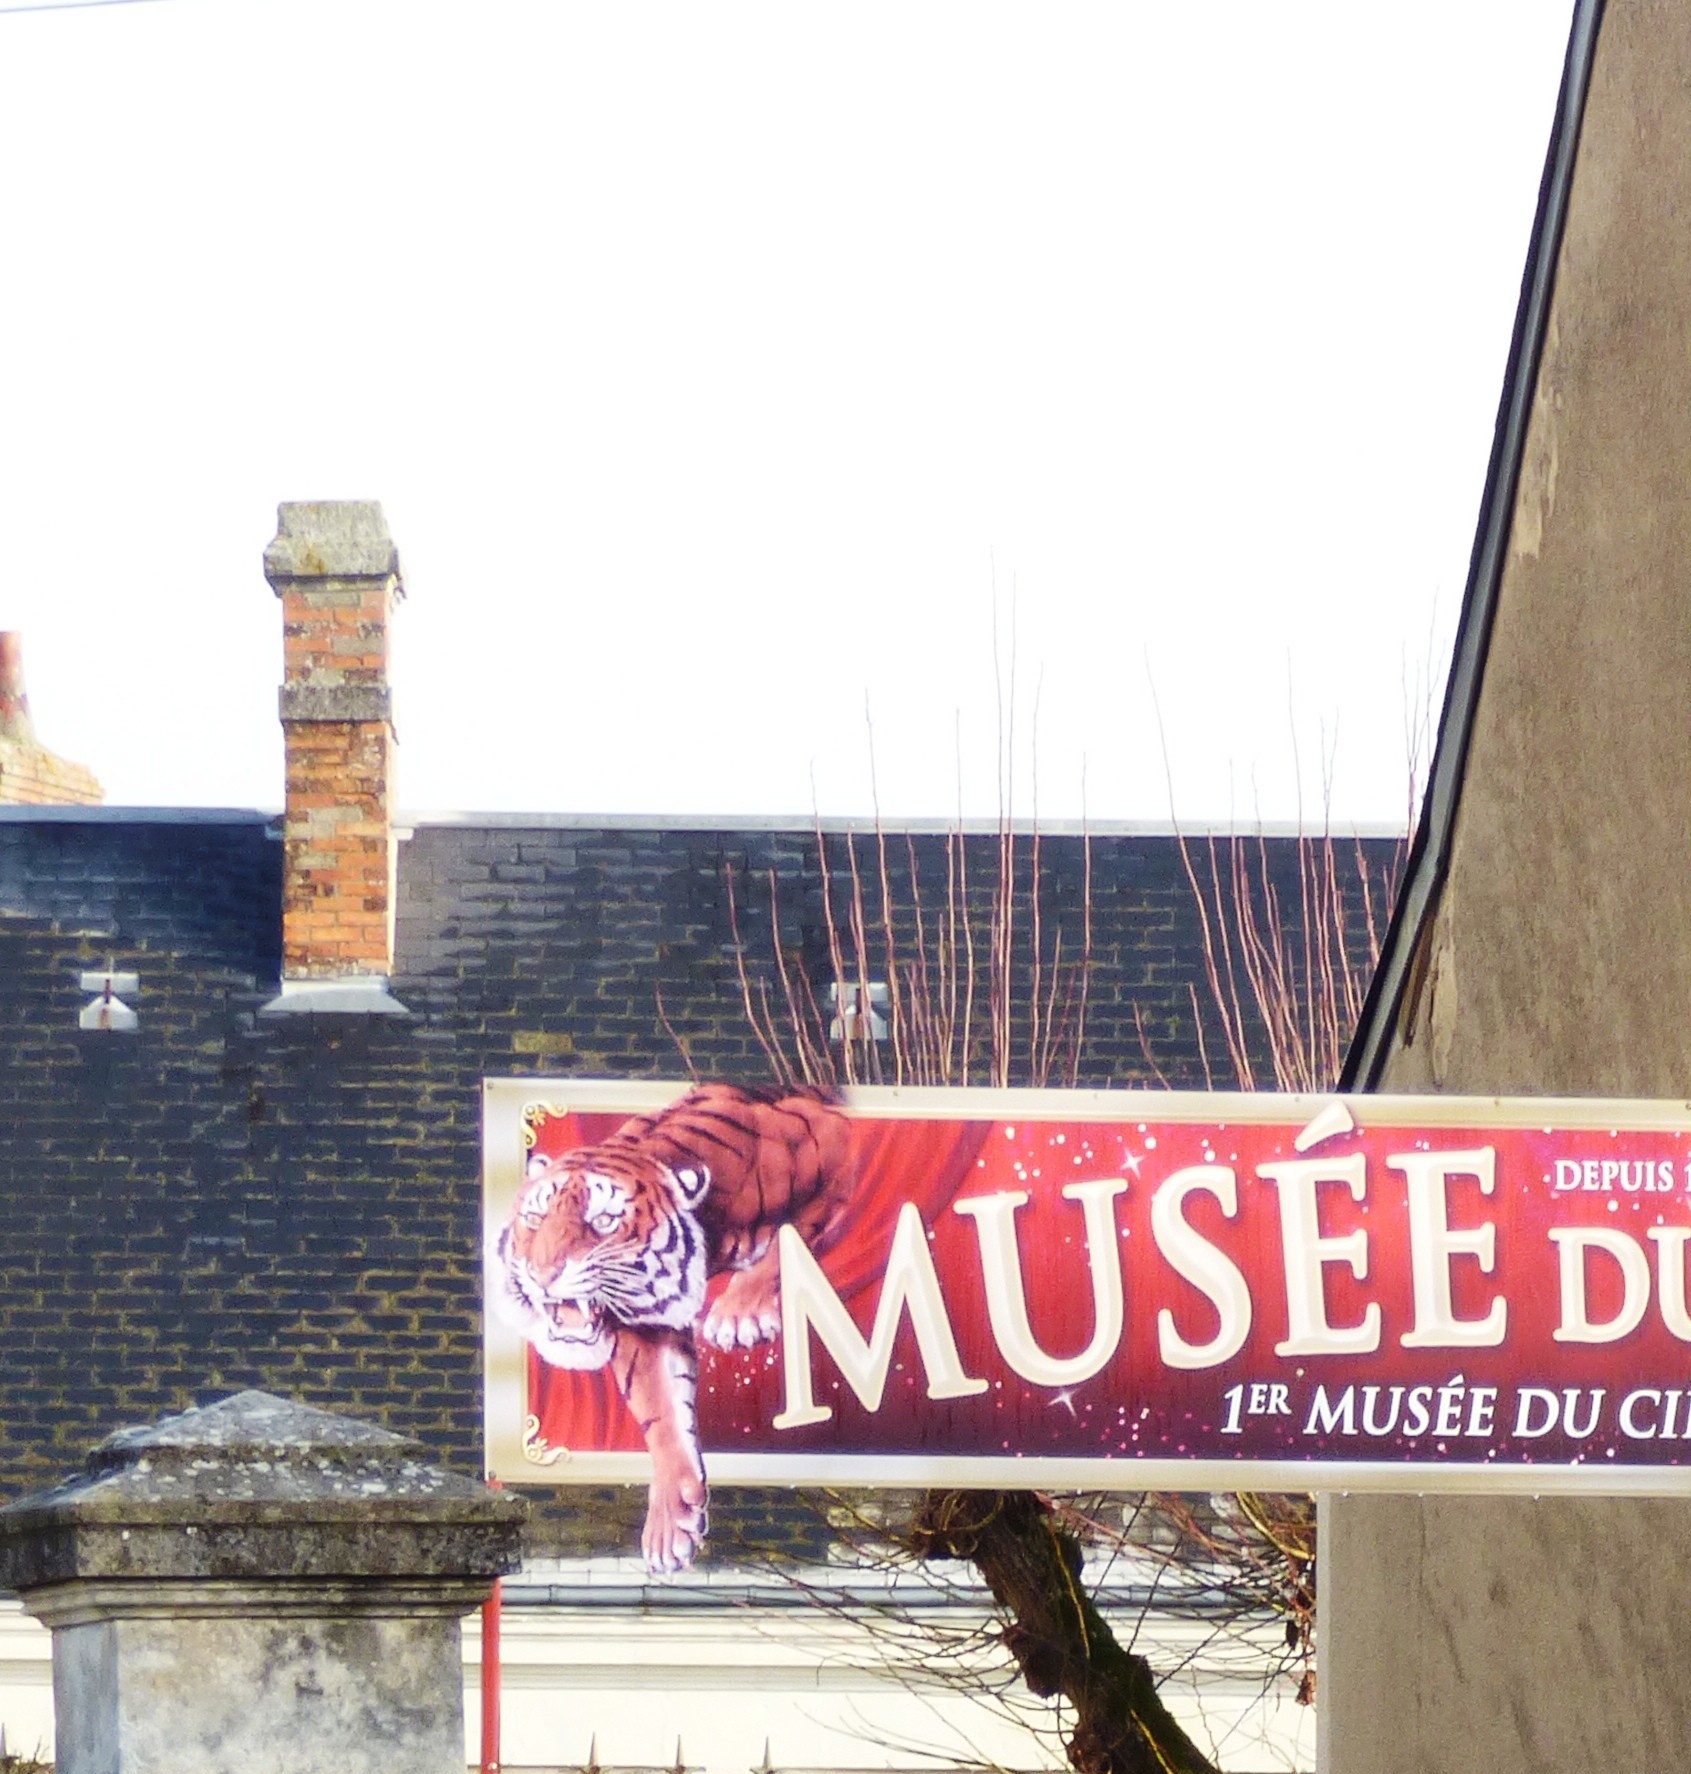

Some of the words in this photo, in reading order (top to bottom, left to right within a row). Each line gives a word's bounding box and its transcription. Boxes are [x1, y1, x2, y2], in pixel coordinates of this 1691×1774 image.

[1554, 1160, 1674, 1192] DEPUIS
[772, 1099, 1507, 1430] MUSÉE
[1303, 1375, 1498, 1437] MUSÉE
[1512, 1387, 1606, 1439] DU
